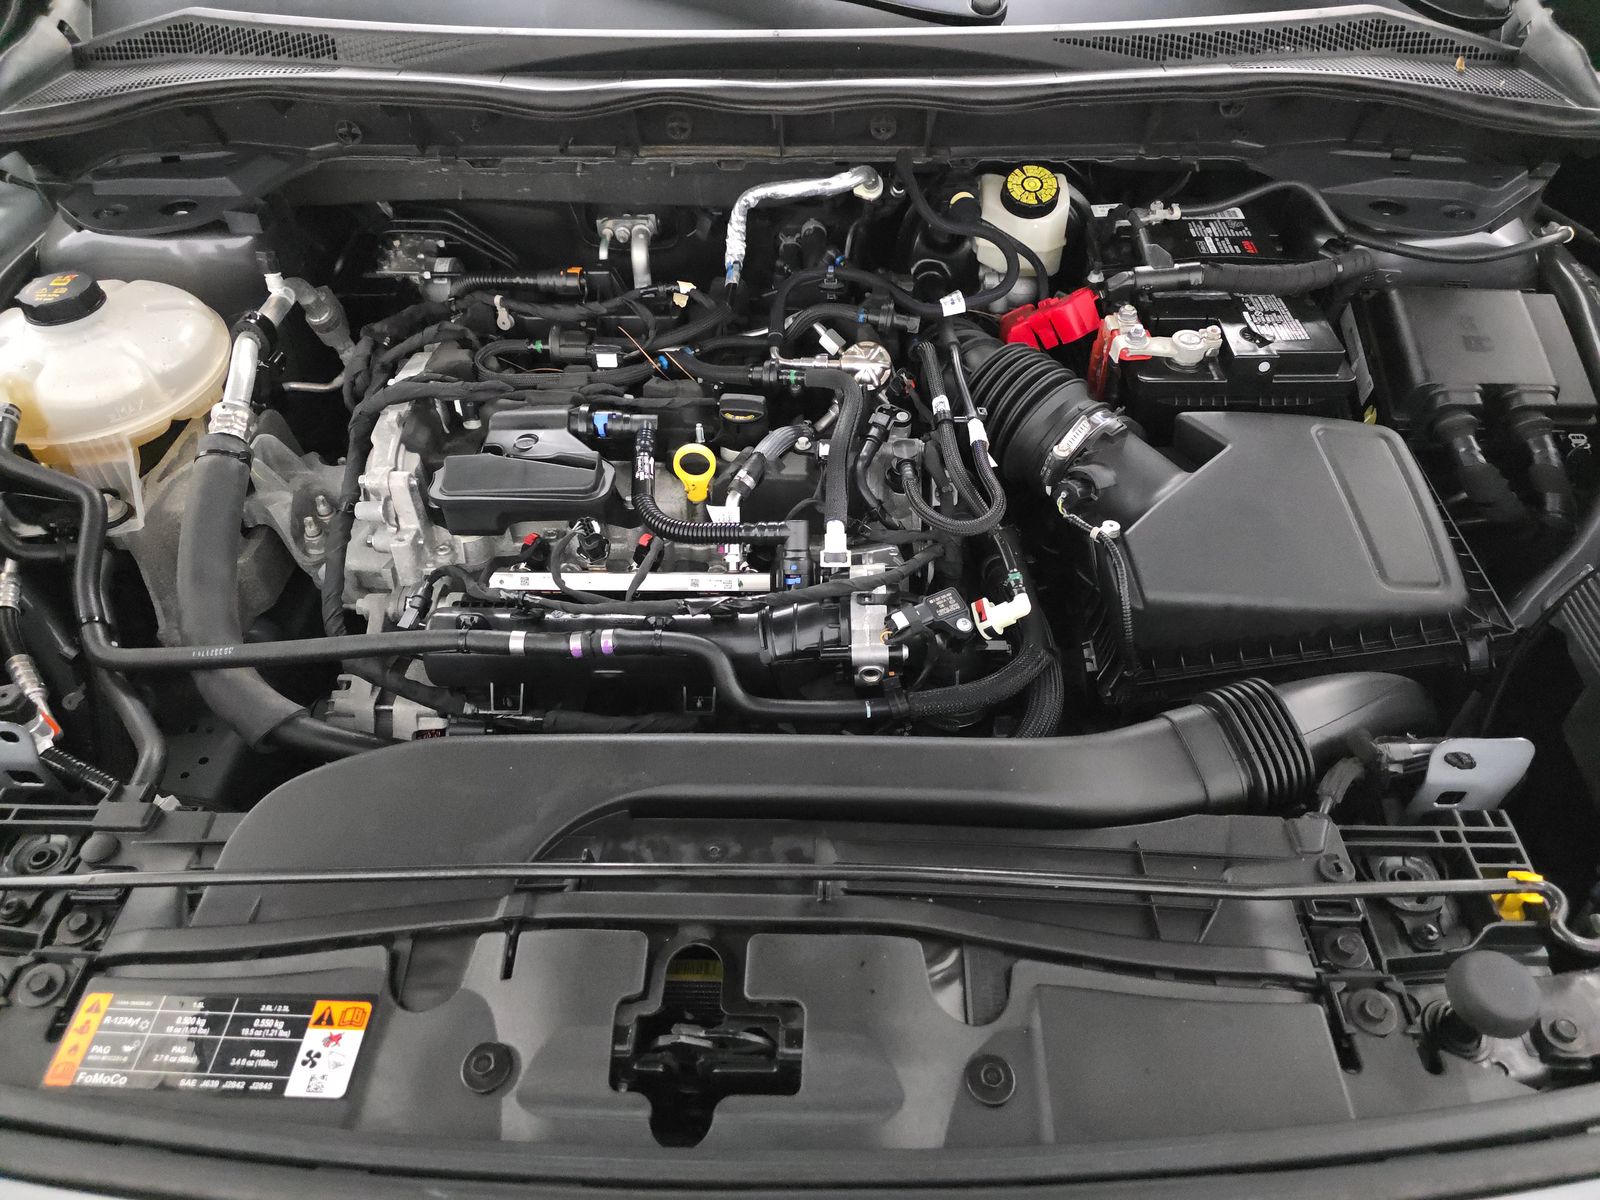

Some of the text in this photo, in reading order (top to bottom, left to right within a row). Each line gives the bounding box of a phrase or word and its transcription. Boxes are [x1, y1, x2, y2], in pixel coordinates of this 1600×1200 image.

[273, 1019, 285, 1030] kg
[90, 1045, 111, 1054] PAG
[170, 1045, 187, 1054] PAG
[249, 1049, 266, 1058] PAG
[76, 1071, 128, 1086] FoMoCo
[178, 1078, 198, 1088] SAE
